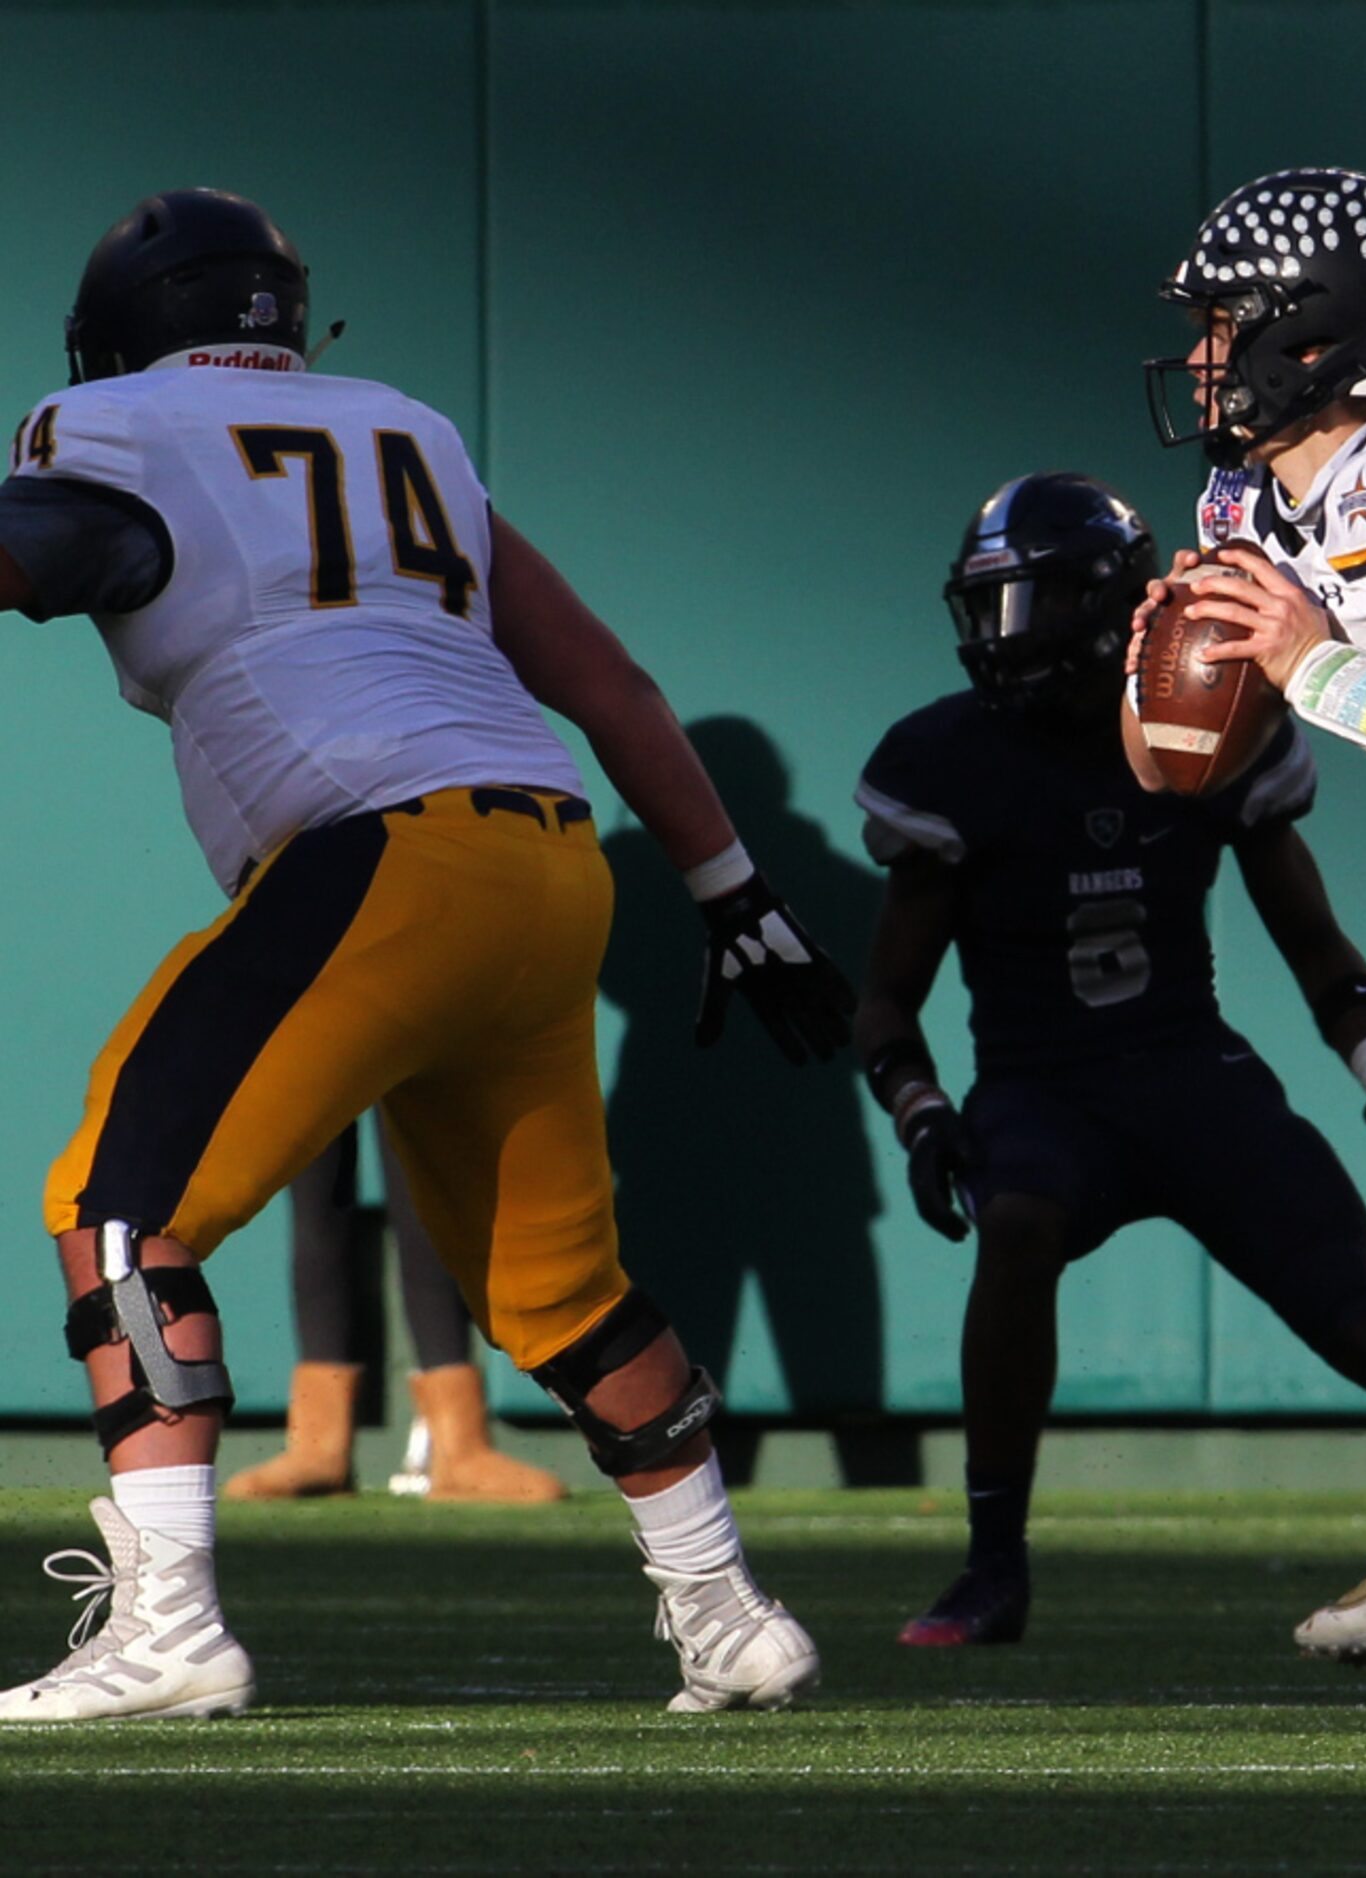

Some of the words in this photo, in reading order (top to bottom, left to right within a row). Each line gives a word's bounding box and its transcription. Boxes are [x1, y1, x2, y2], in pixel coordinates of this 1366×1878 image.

[227, 423, 480, 621] 74
[1156, 614, 1188, 699] Wilson
[1068, 868, 1144, 896] RANGERS
